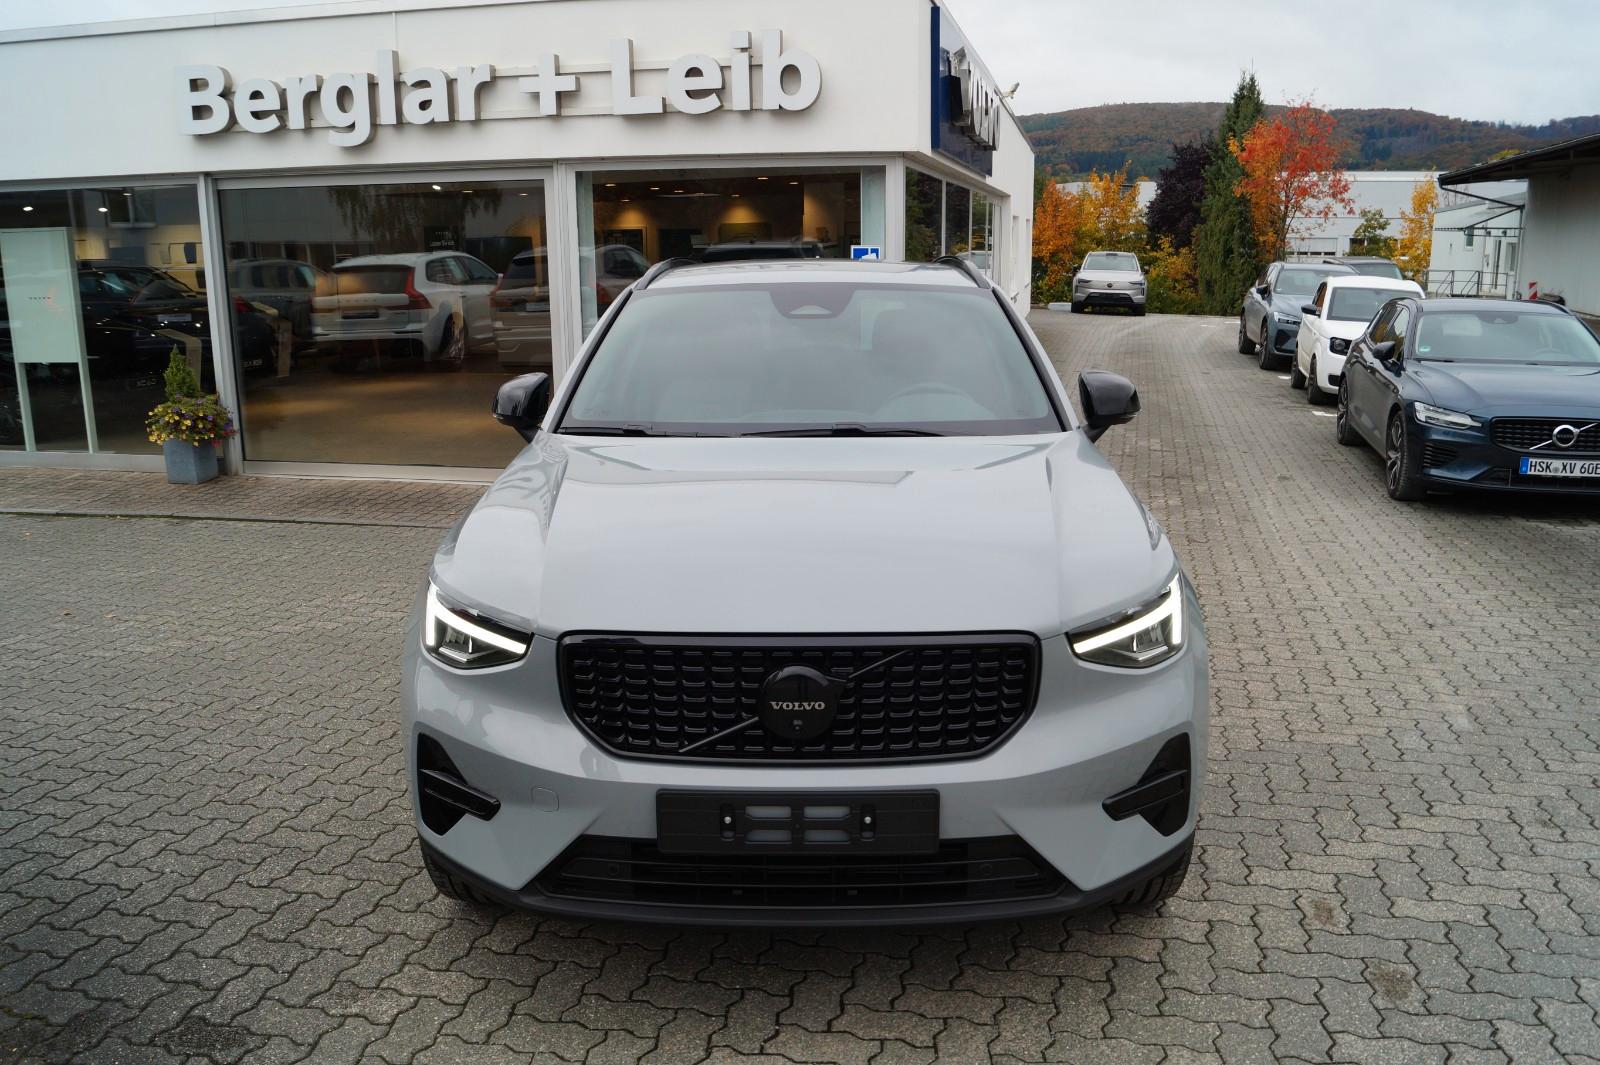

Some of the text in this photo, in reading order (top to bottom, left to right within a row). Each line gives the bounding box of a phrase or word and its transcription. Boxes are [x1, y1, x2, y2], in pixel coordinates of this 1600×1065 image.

[175, 29, 822, 147] Berglar + Leib
[1529, 461, 1553, 474] HSK
[1560, 462, 1577, 474] XV
[769, 701, 826, 711] VOLVO
